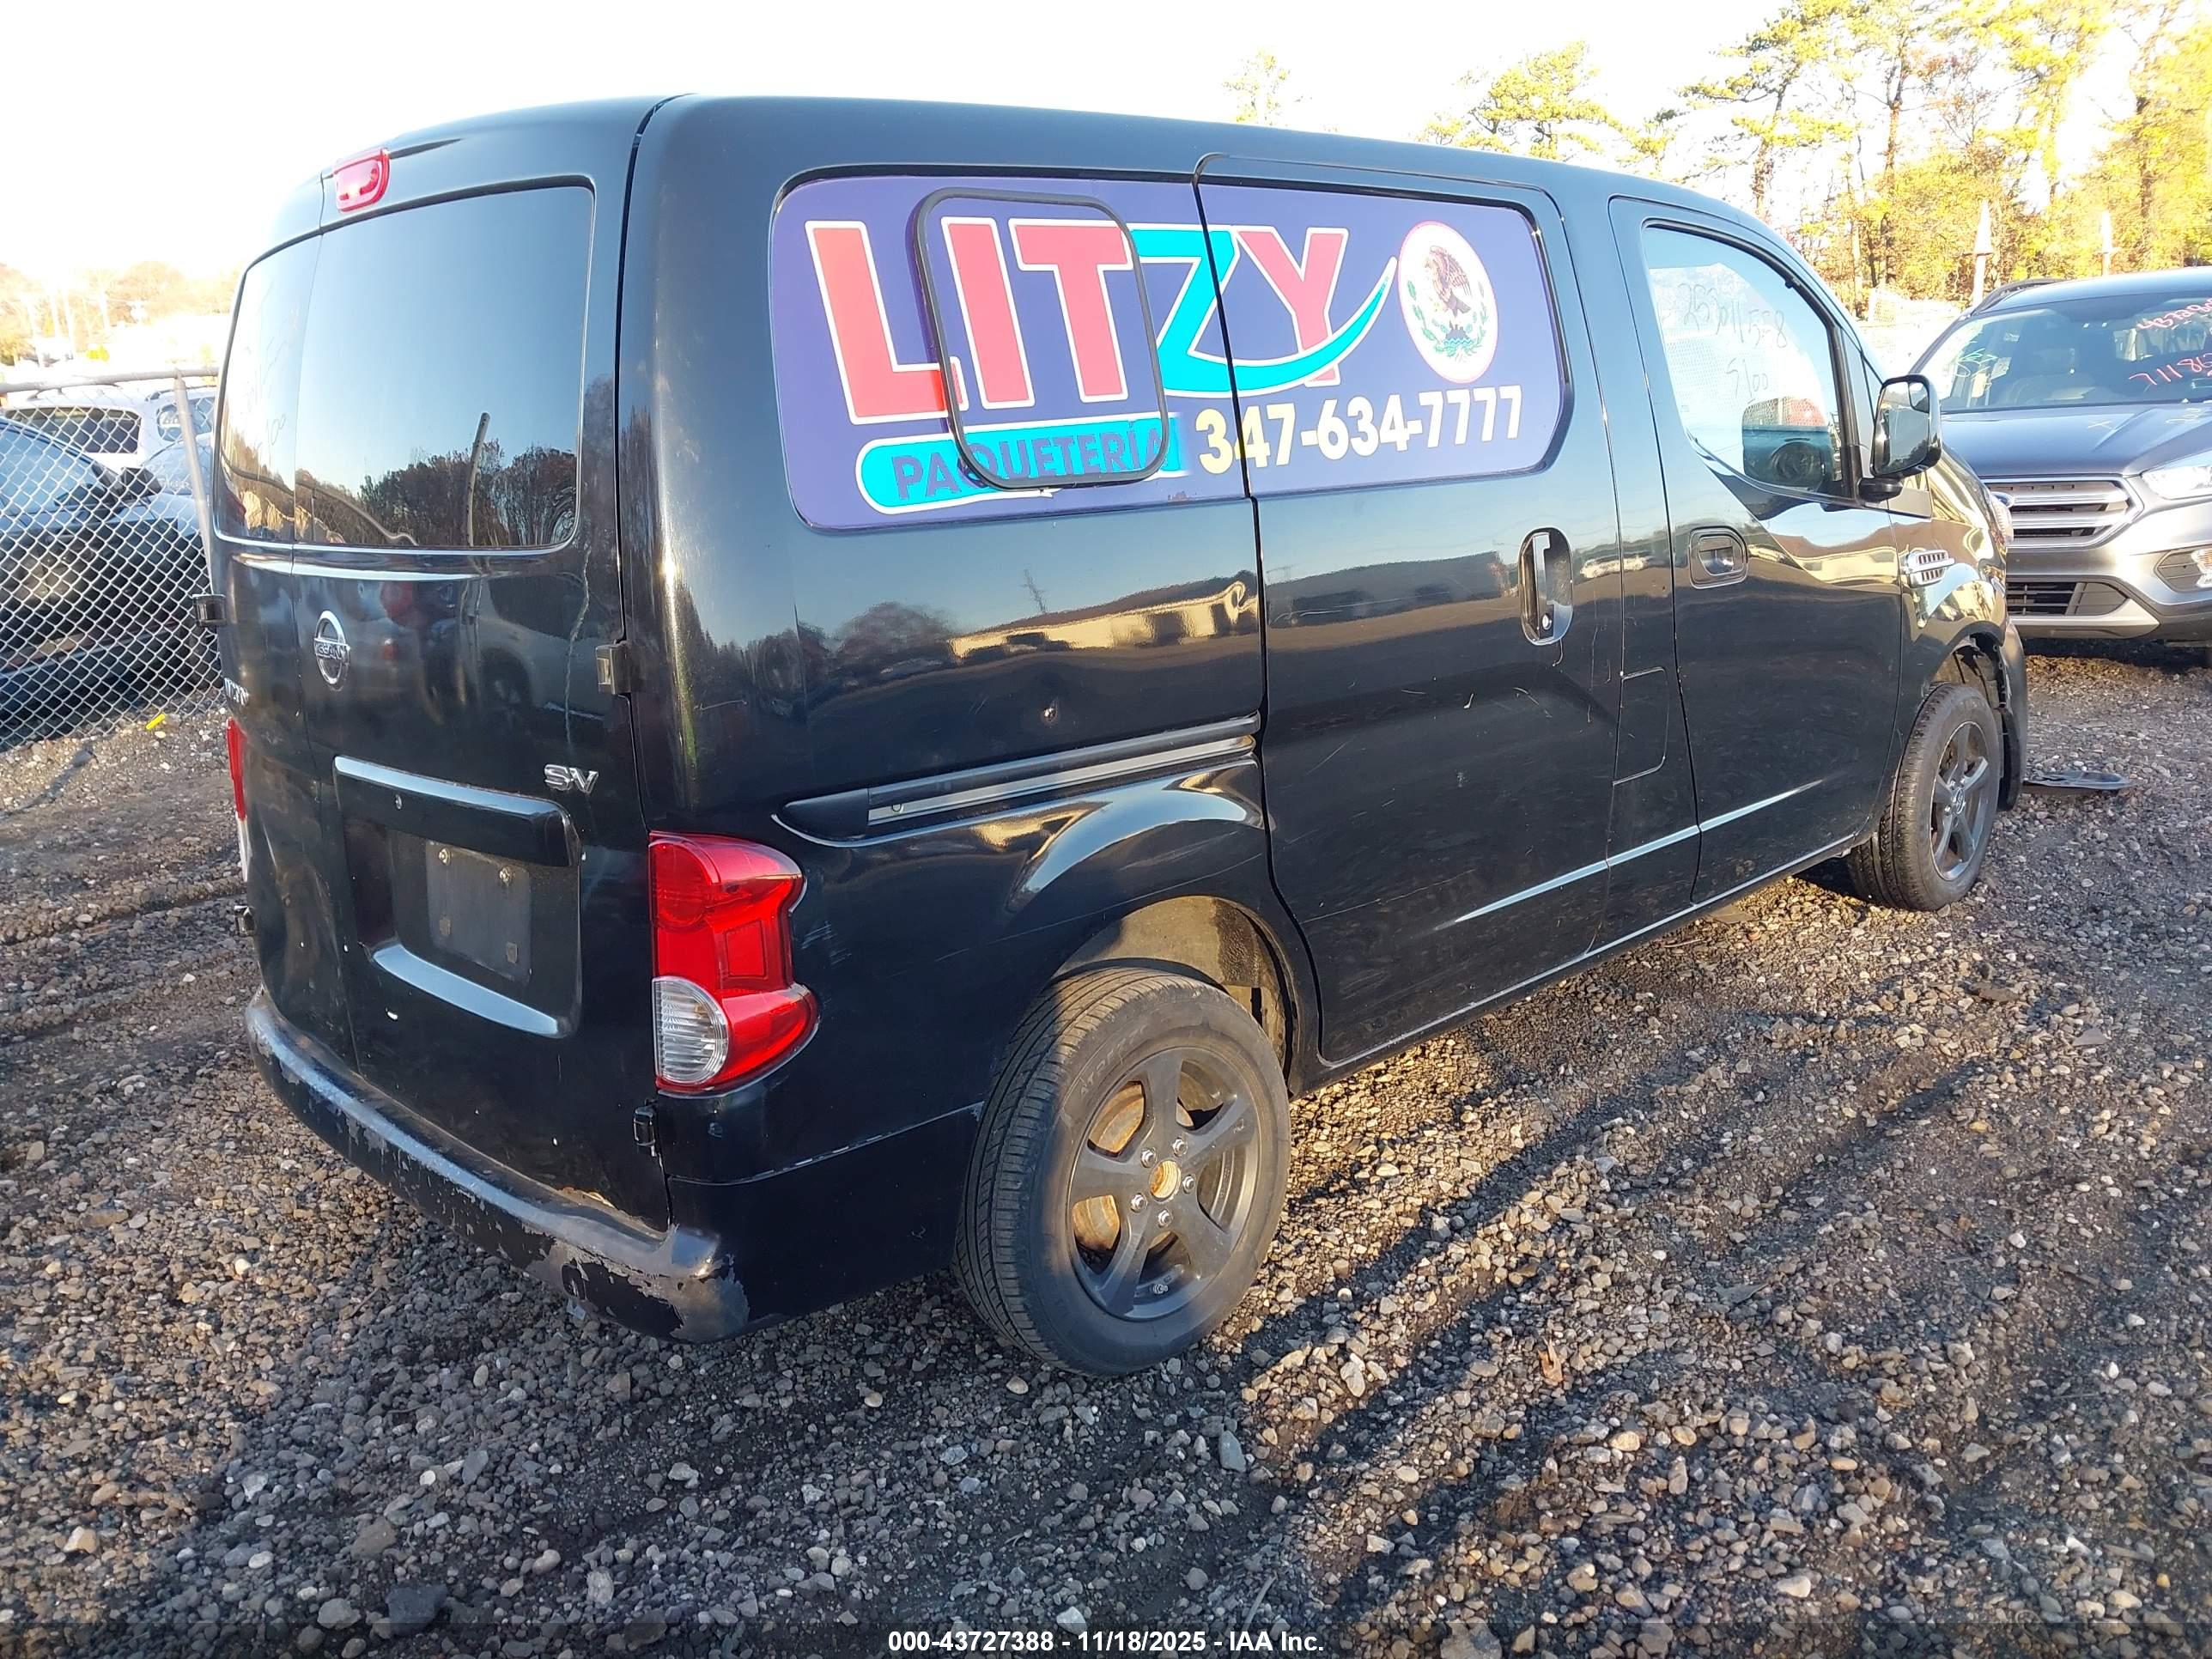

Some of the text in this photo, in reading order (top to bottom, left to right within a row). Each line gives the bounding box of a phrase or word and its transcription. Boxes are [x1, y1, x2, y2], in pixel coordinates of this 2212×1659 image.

[805, 217, 1397, 423] LITZY
[1195, 385, 1523, 475] 347-634-7777
[544, 763, 599, 796] SV
